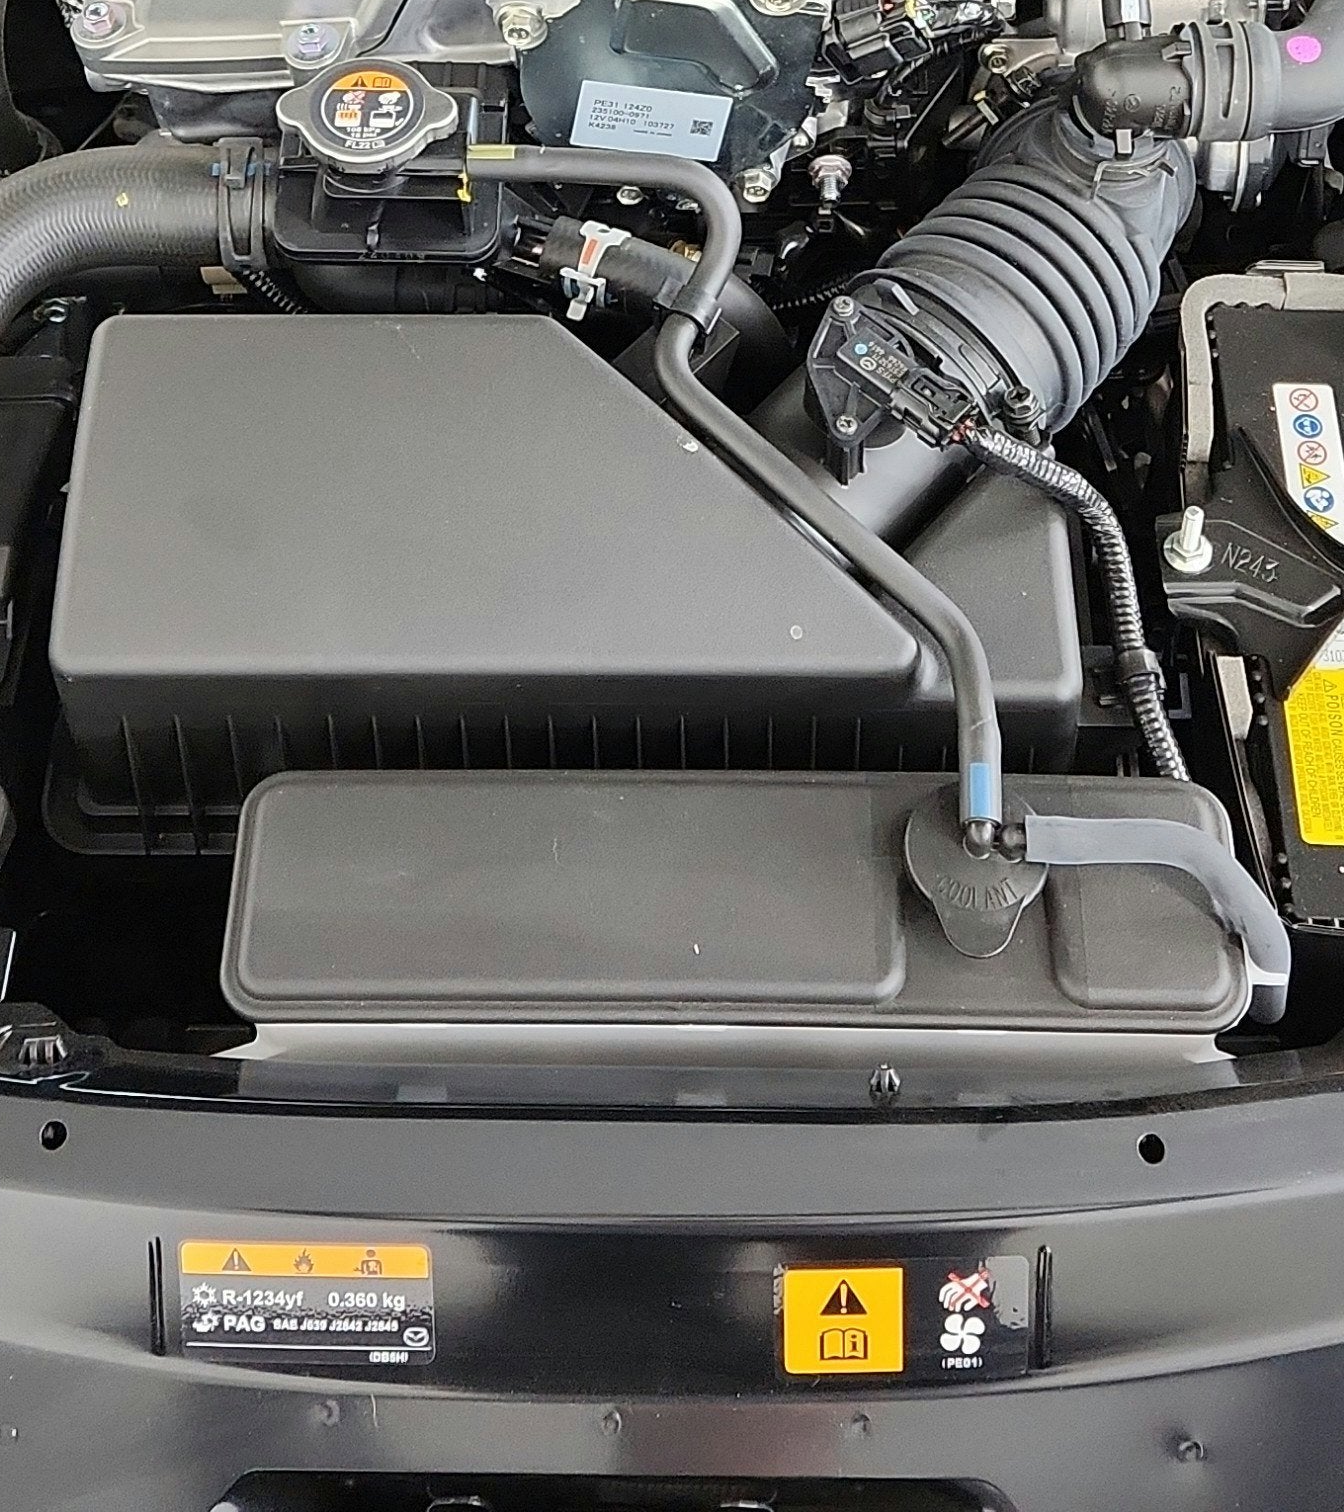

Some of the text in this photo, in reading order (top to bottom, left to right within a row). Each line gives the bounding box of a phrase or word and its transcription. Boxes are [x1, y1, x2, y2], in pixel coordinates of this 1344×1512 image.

[593, 99, 619, 109] PE31
[589, 114, 606, 123] 12V
[345, 140, 370, 149] FL22
[1220, 542, 1280, 583] N243
[1324, 695, 1344, 736] POISON
[1296, 693, 1323, 818] KEEP OUT OF REACH OF CHILDREN
[937, 876, 1017, 909] COOLANT
[222, 1289, 406, 1311] R-1234yf 0.360 kg
[223, 1313, 266, 1332] PAG
[941, 1356, 983, 1369] (PE01)
